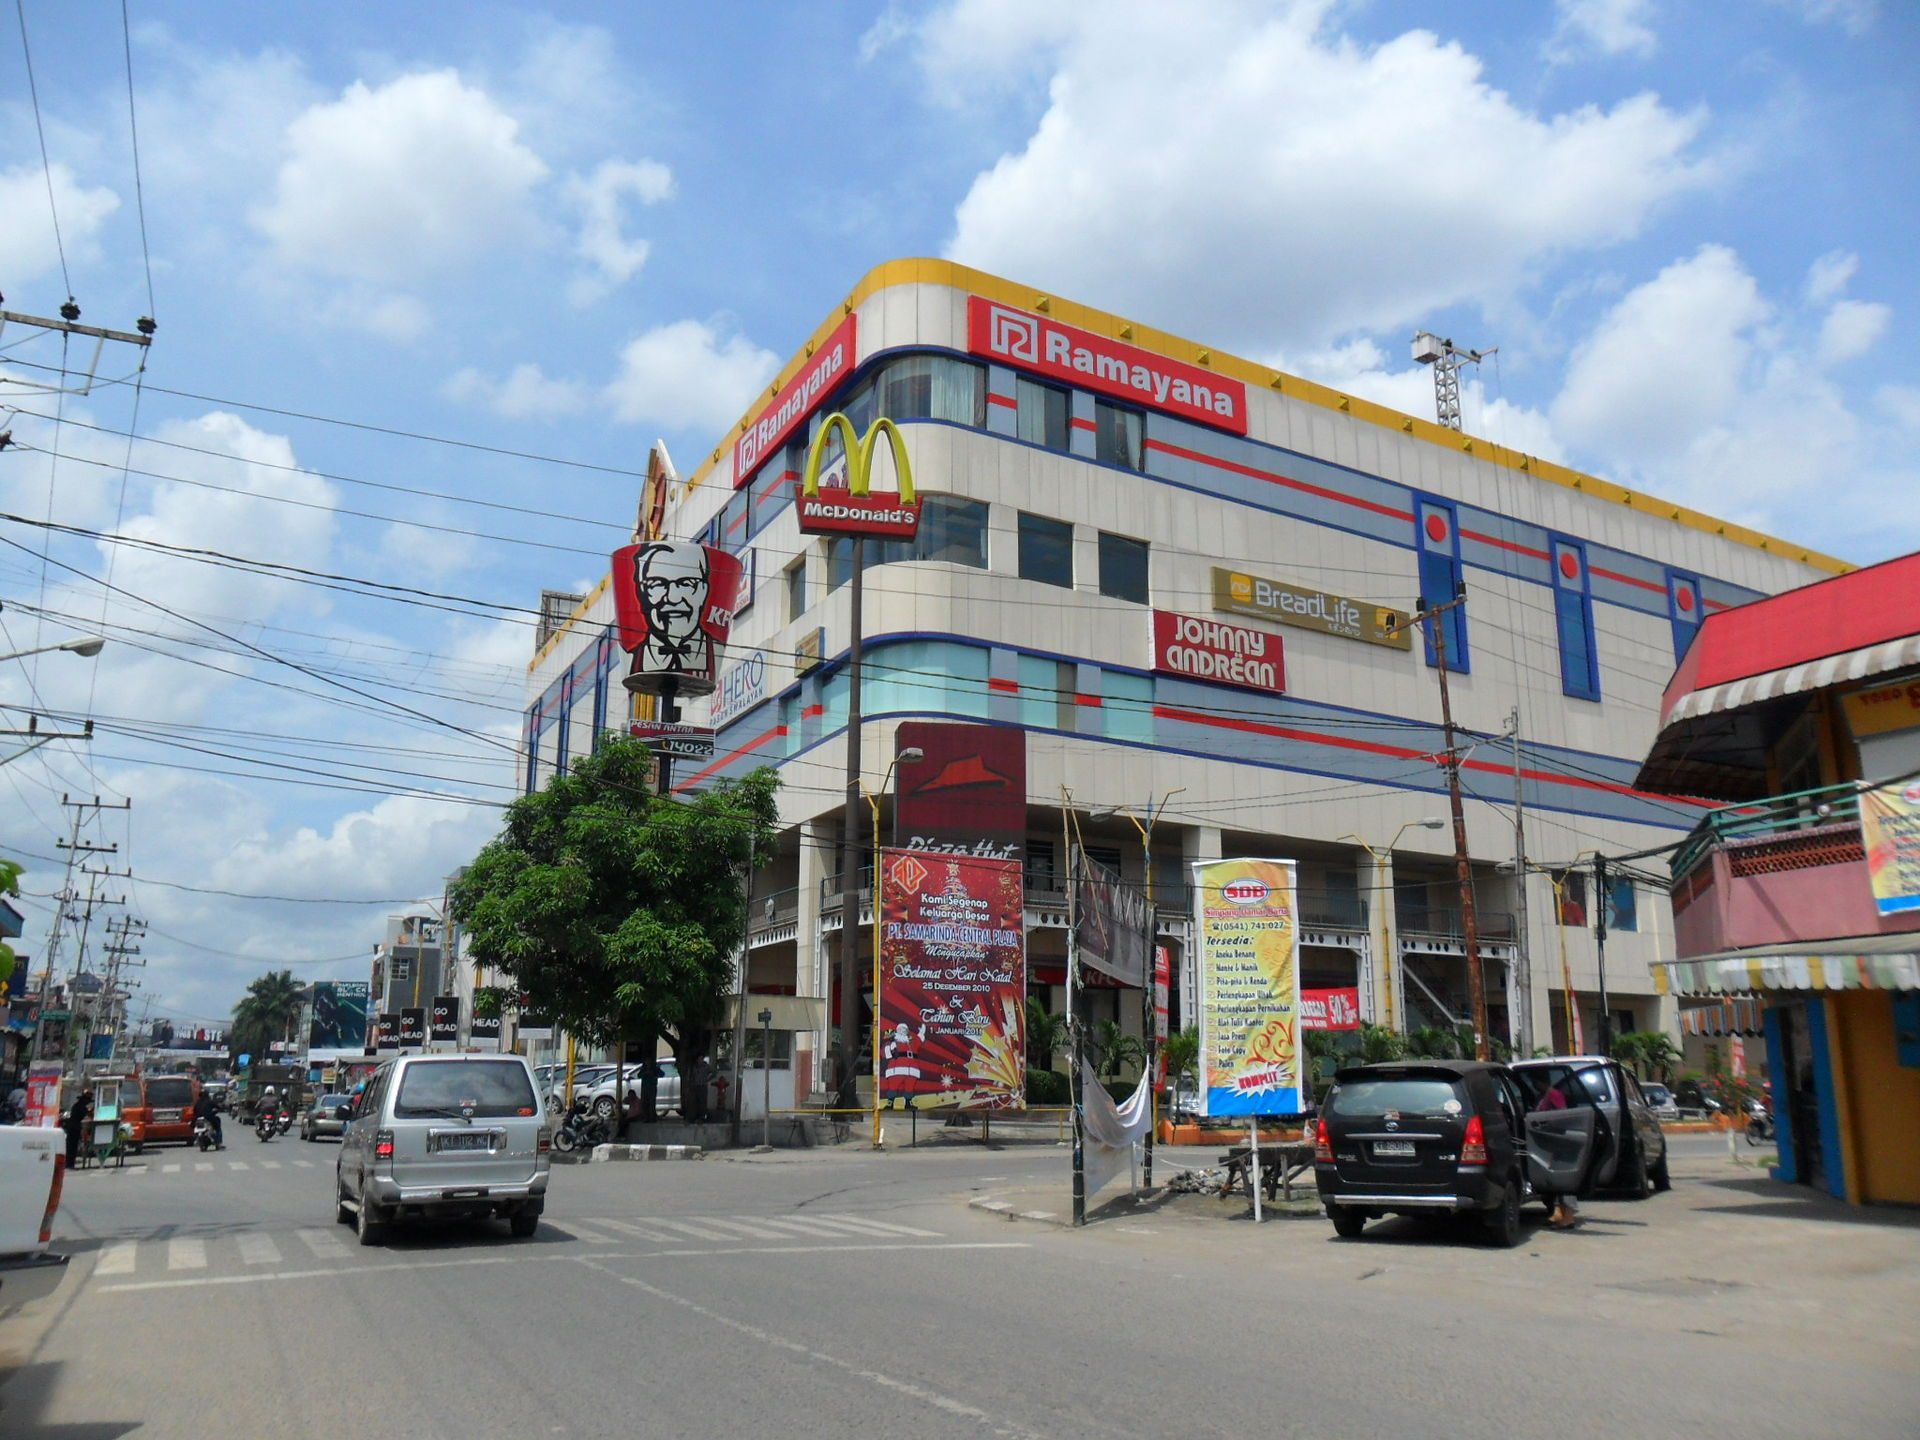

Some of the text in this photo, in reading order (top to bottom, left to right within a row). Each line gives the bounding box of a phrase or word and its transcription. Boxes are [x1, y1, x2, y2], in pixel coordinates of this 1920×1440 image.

[1046, 329, 1234, 418] Ramayana
[757, 343, 843, 453] Ramayana
[803, 502, 915, 524] McDonald's
[1255, 580, 1360, 628] BreadLife
[723, 651, 763, 708] HERO
[669, 740, 713, 755] 14022
[921, 893, 988, 909] Kami Segenap
[920, 906, 990, 921] Keluarga Besar
[1220, 921, 1284, 931] (0541) 741 027
[888, 922, 1017, 946] PT. SAMARINDA CENTRAL PLAZA
[1207, 935, 1254, 946] Tersedia:
[924, 944, 988, 960] Mengucapkan
[1234, 949, 1255, 959] Benang
[893, 964, 1013, 983] Selamat Hari Natal
[922, 981, 991, 993] 25 DESEMBER 2010
[1250, 976, 1267, 985] Renda
[949, 994, 964, 1008] &
[1217, 990, 1255, 1000] Perlengkapan
[434, 1007, 448, 1016] GO
[1217, 1003, 1256, 1014] Perlengkapan
[1257, 1003, 1290, 1013] Pernikahan
[402, 1017, 415, 1025] GO
[472, 1018, 500, 1028] HEAD
[919, 1008, 991, 1025] Tahun Baru
[379, 1022, 392, 1030] GO
[432, 1024, 457, 1032] HEAD
[935, 1027, 965, 1035] JANUARI
[965, 1028, 982, 1036] 2011
[401, 1031, 423, 1039] HEAD
[1238, 1070, 1278, 1089] KOMPLIT
